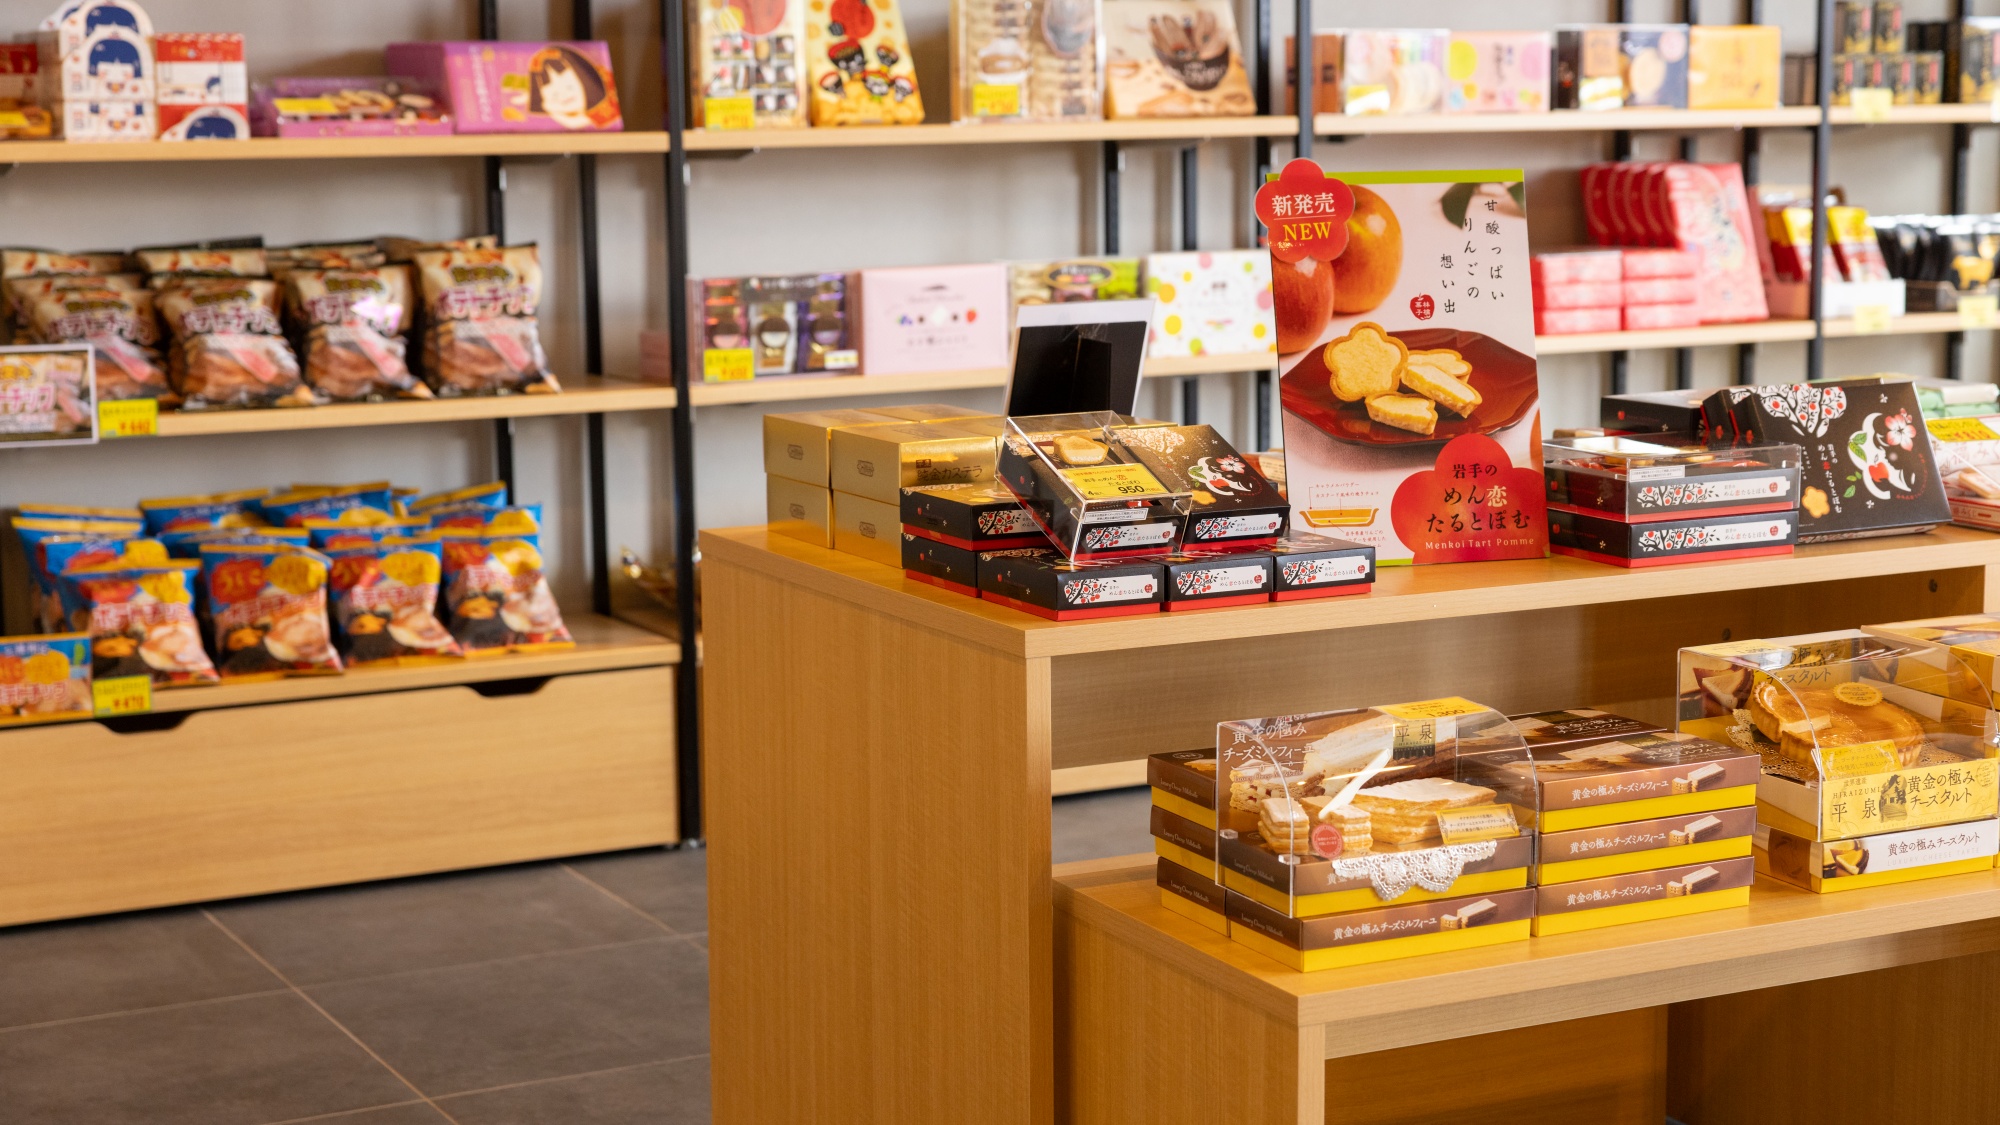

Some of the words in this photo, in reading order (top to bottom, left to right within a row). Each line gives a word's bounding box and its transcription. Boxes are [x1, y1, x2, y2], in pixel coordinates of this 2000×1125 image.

[1271, 192, 1335, 217] 新発売
[1282, 221, 1332, 242] NEW
[1463, 217, 1480, 298] りんごの
[1485, 199, 1505, 300] 甘酸っぱい
[1440, 254, 1456, 314] 想い出
[1452, 463, 1497, 479] 岩手の
[1118, 485, 1145, 494] 950
[1444, 485, 1508, 507] めん恋
[1427, 509, 1531, 533] たるとぽむ
[1425, 540, 1466, 550] Menkoi
[1468, 538, 1491, 548] Tart
[1496, 537, 1534, 547] Pomme
[1232, 722, 1307, 745] 黄金の極み
[1223, 743, 1315, 763] チーズミルフィーユ
[1572, 780, 1669, 801] 黄金の極みチーズミルフィーユ
[1833, 787, 1881, 799] HIRAIZUMI
[1907, 769, 1976, 795] 黄金の極み
[1832, 797, 1877, 823] 平泉
[1910, 788, 1973, 810] チーズタルト
[1569, 832, 1666, 855] 黄金の極みチーズミルフィーユ
[1888, 832, 1980, 857] 黄金の極みチーズタルト
[1566, 883, 1664, 906] 黄金の極みチーズミルフィーユ
[1332, 917, 1438, 941] 黄金の極みチーズミルフィーユ
